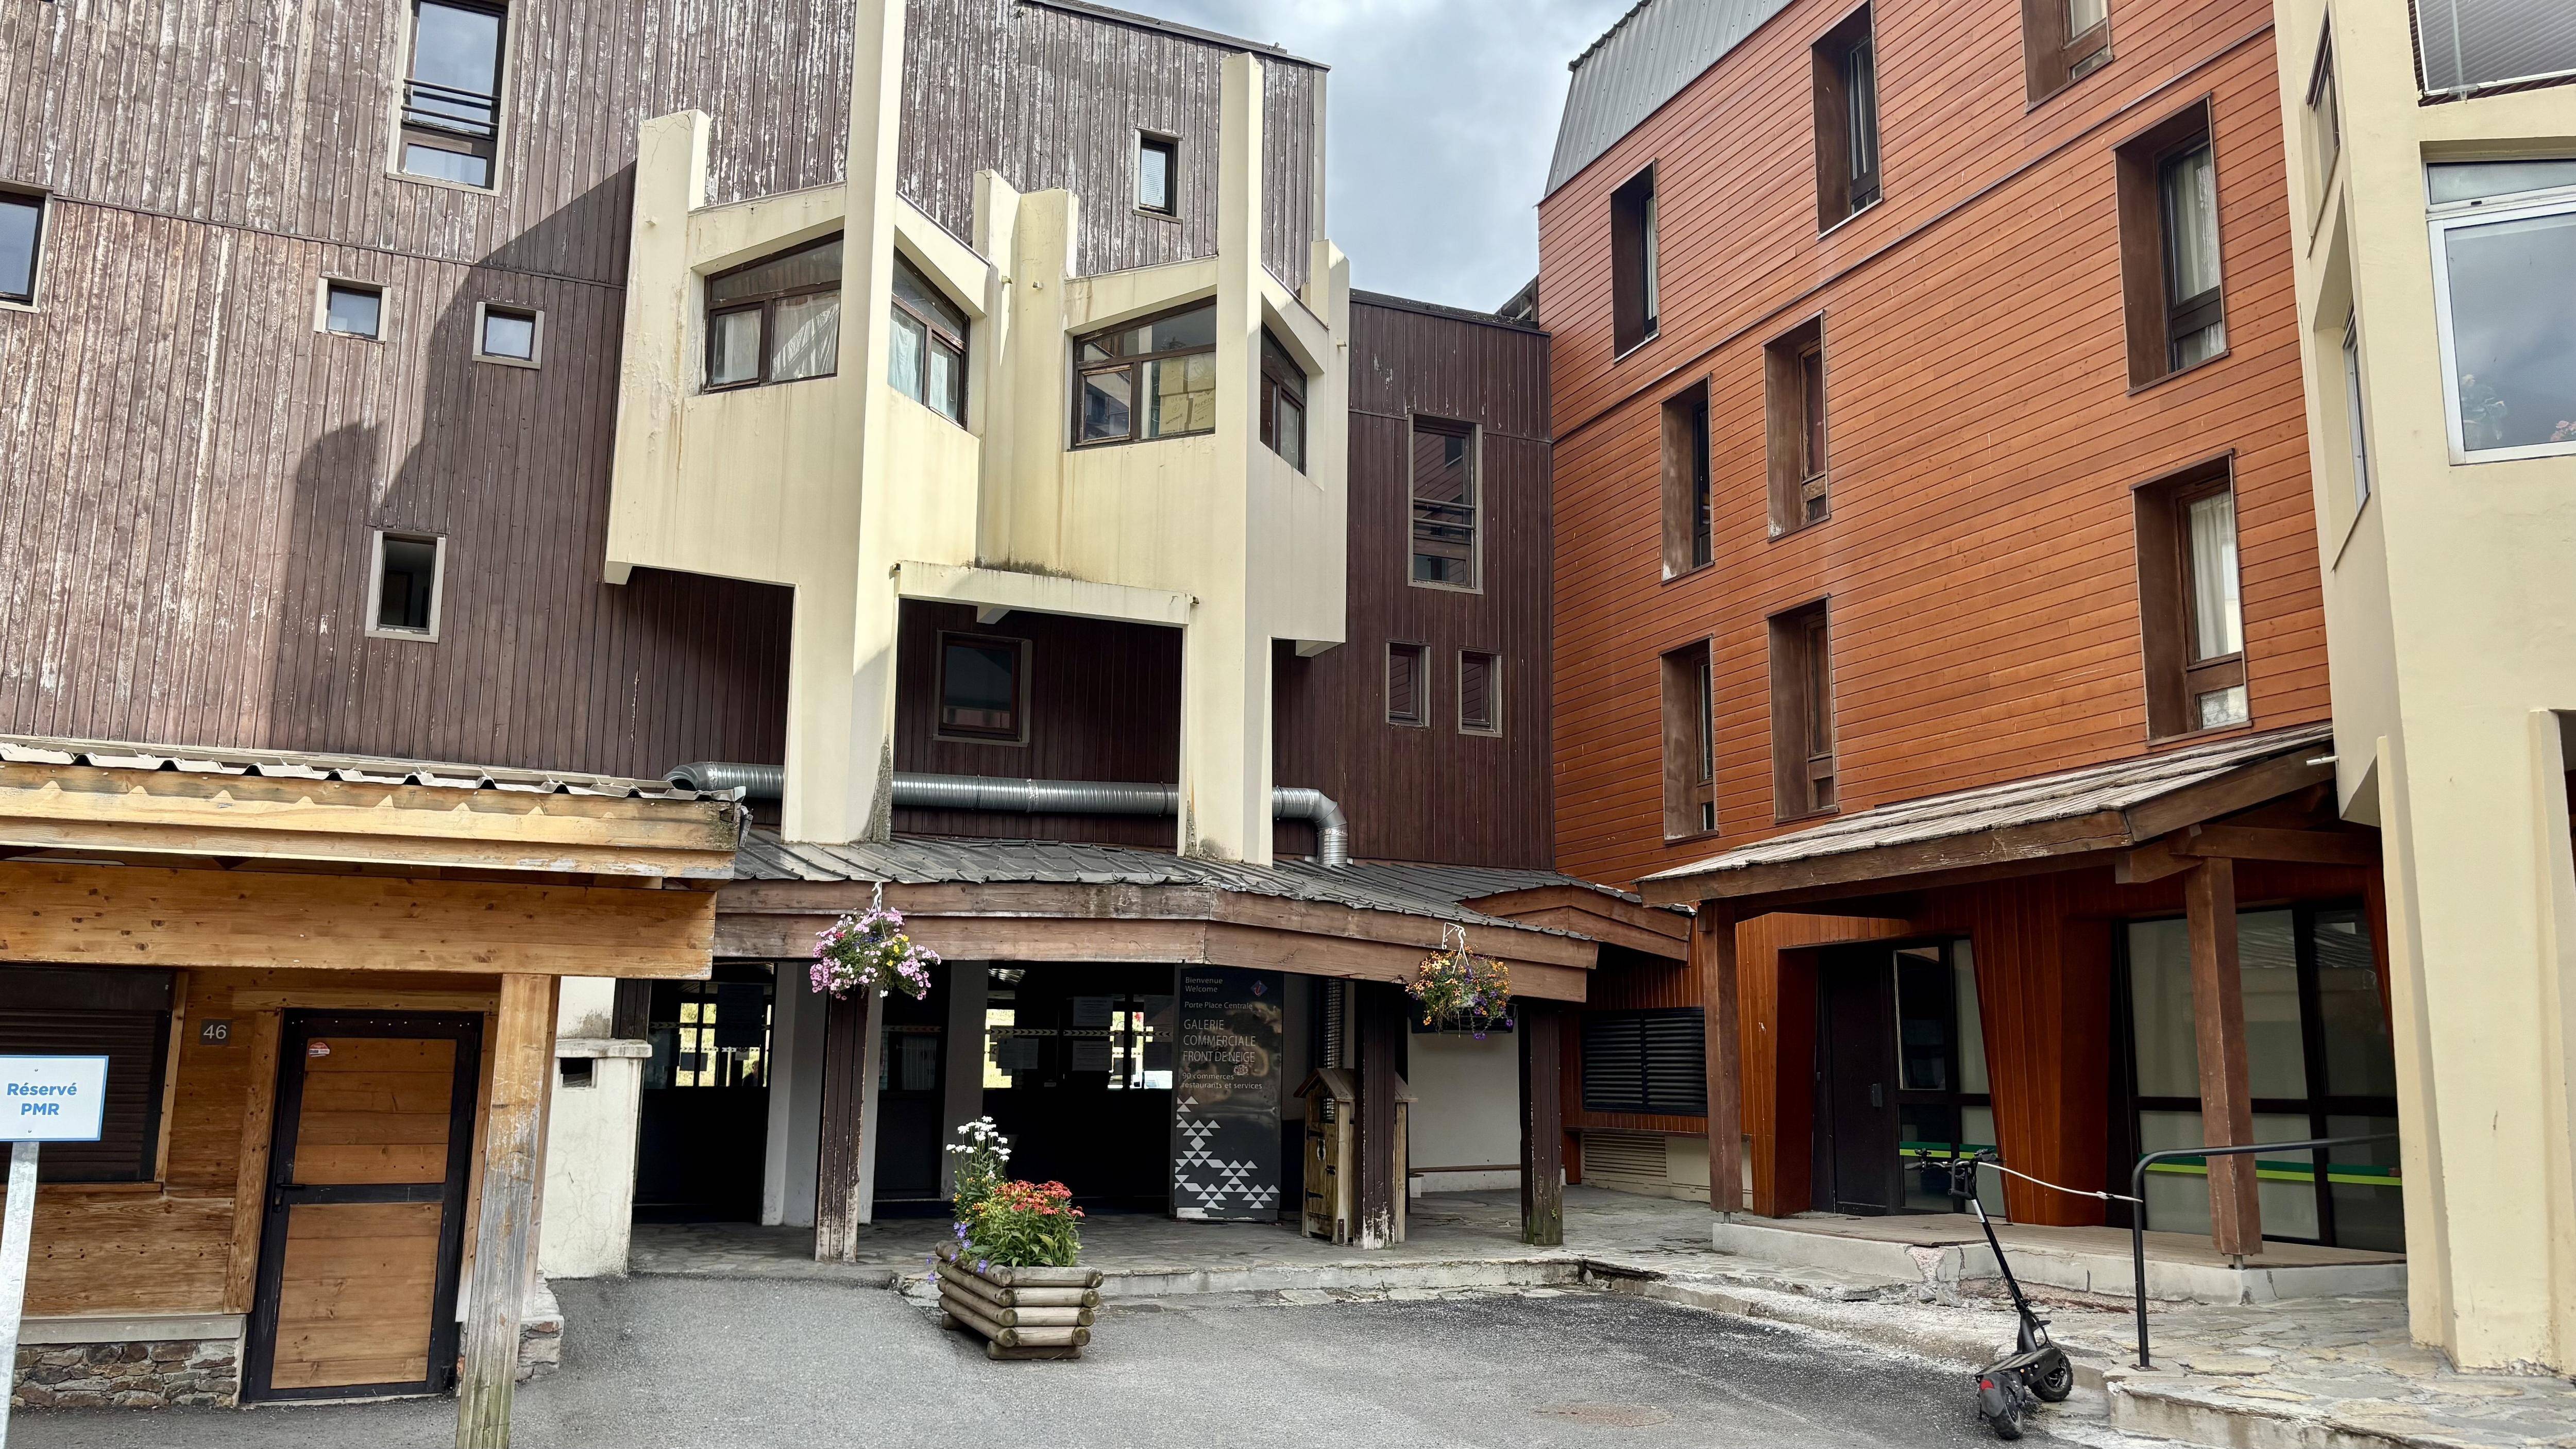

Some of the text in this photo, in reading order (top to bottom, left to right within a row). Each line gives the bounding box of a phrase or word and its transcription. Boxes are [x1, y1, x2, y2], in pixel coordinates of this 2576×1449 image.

[1183, 1019, 1224, 1030] GALERIE
[203, 1024, 227, 1039] 46
[1183, 1035, 1256, 1047] COMMERCIALE
[1183, 1051, 1256, 1063] FRONT DE NEIGE
[7, 1082, 77, 1096] Réservé
[21, 1103, 60, 1116] PMR
